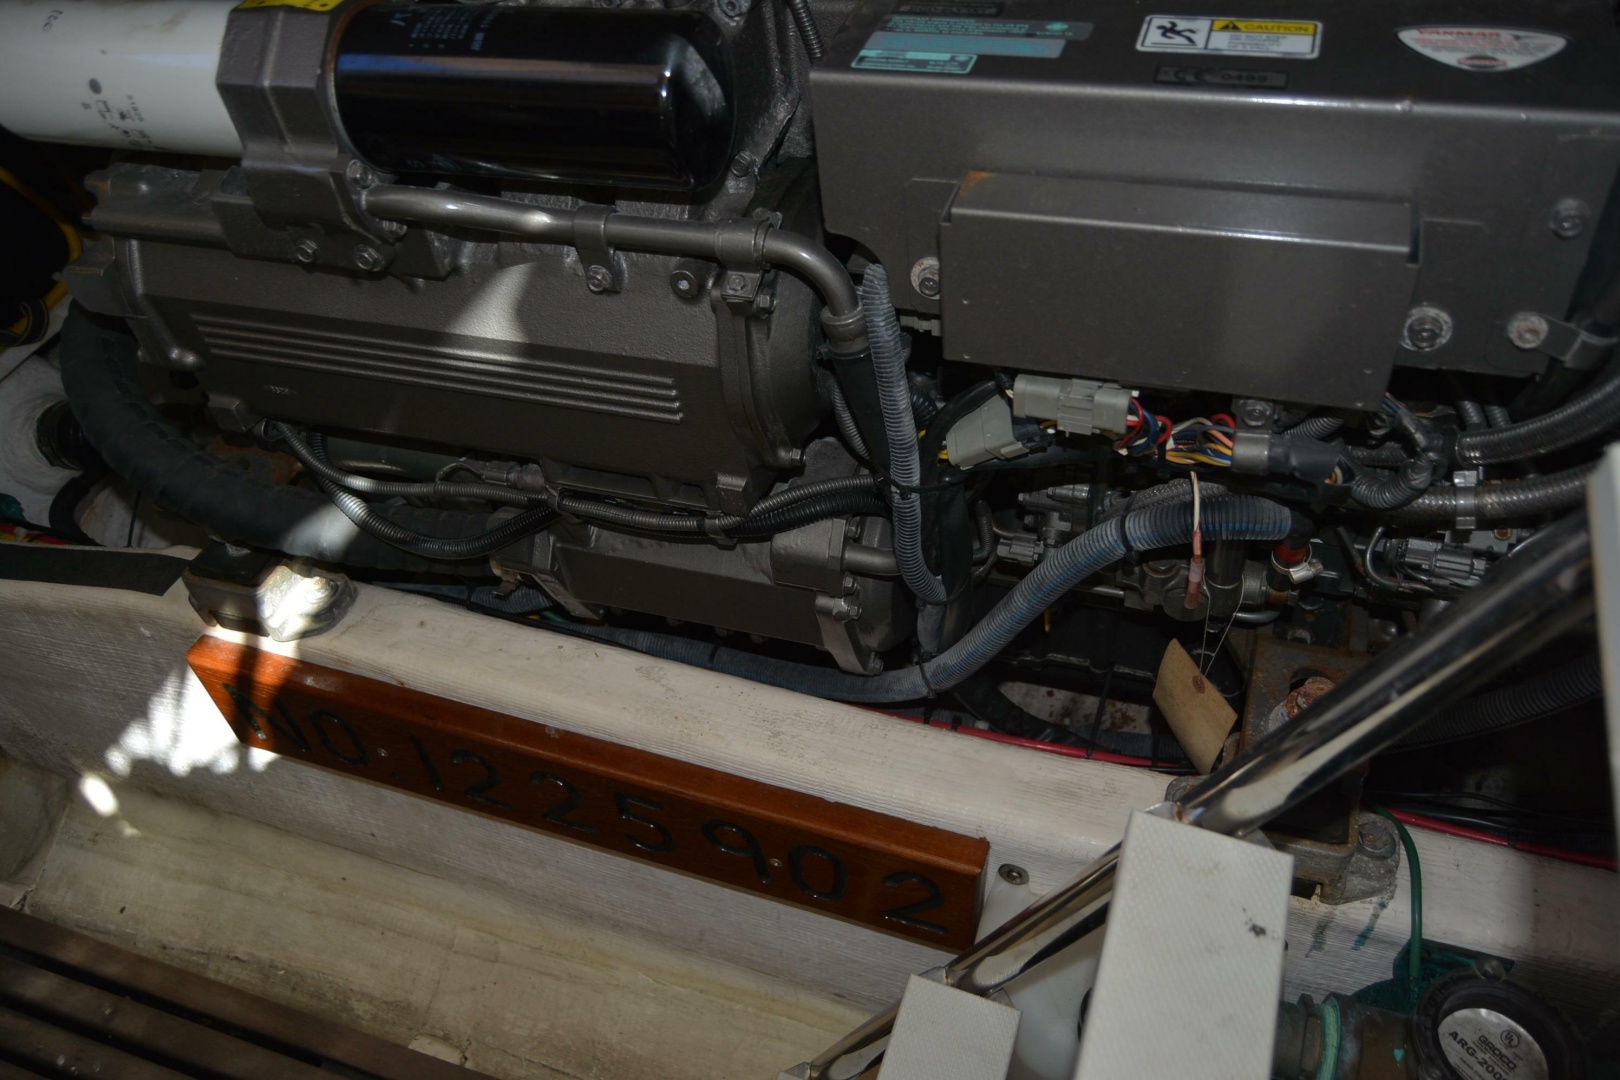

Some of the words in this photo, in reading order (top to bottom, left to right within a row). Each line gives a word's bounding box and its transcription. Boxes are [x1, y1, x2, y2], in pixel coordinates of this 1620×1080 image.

[1244, 23, 1309, 33] CAUTION
[1417, 28, 1502, 38] YANMAR
[1478, 1034, 1517, 1070] GROCO
